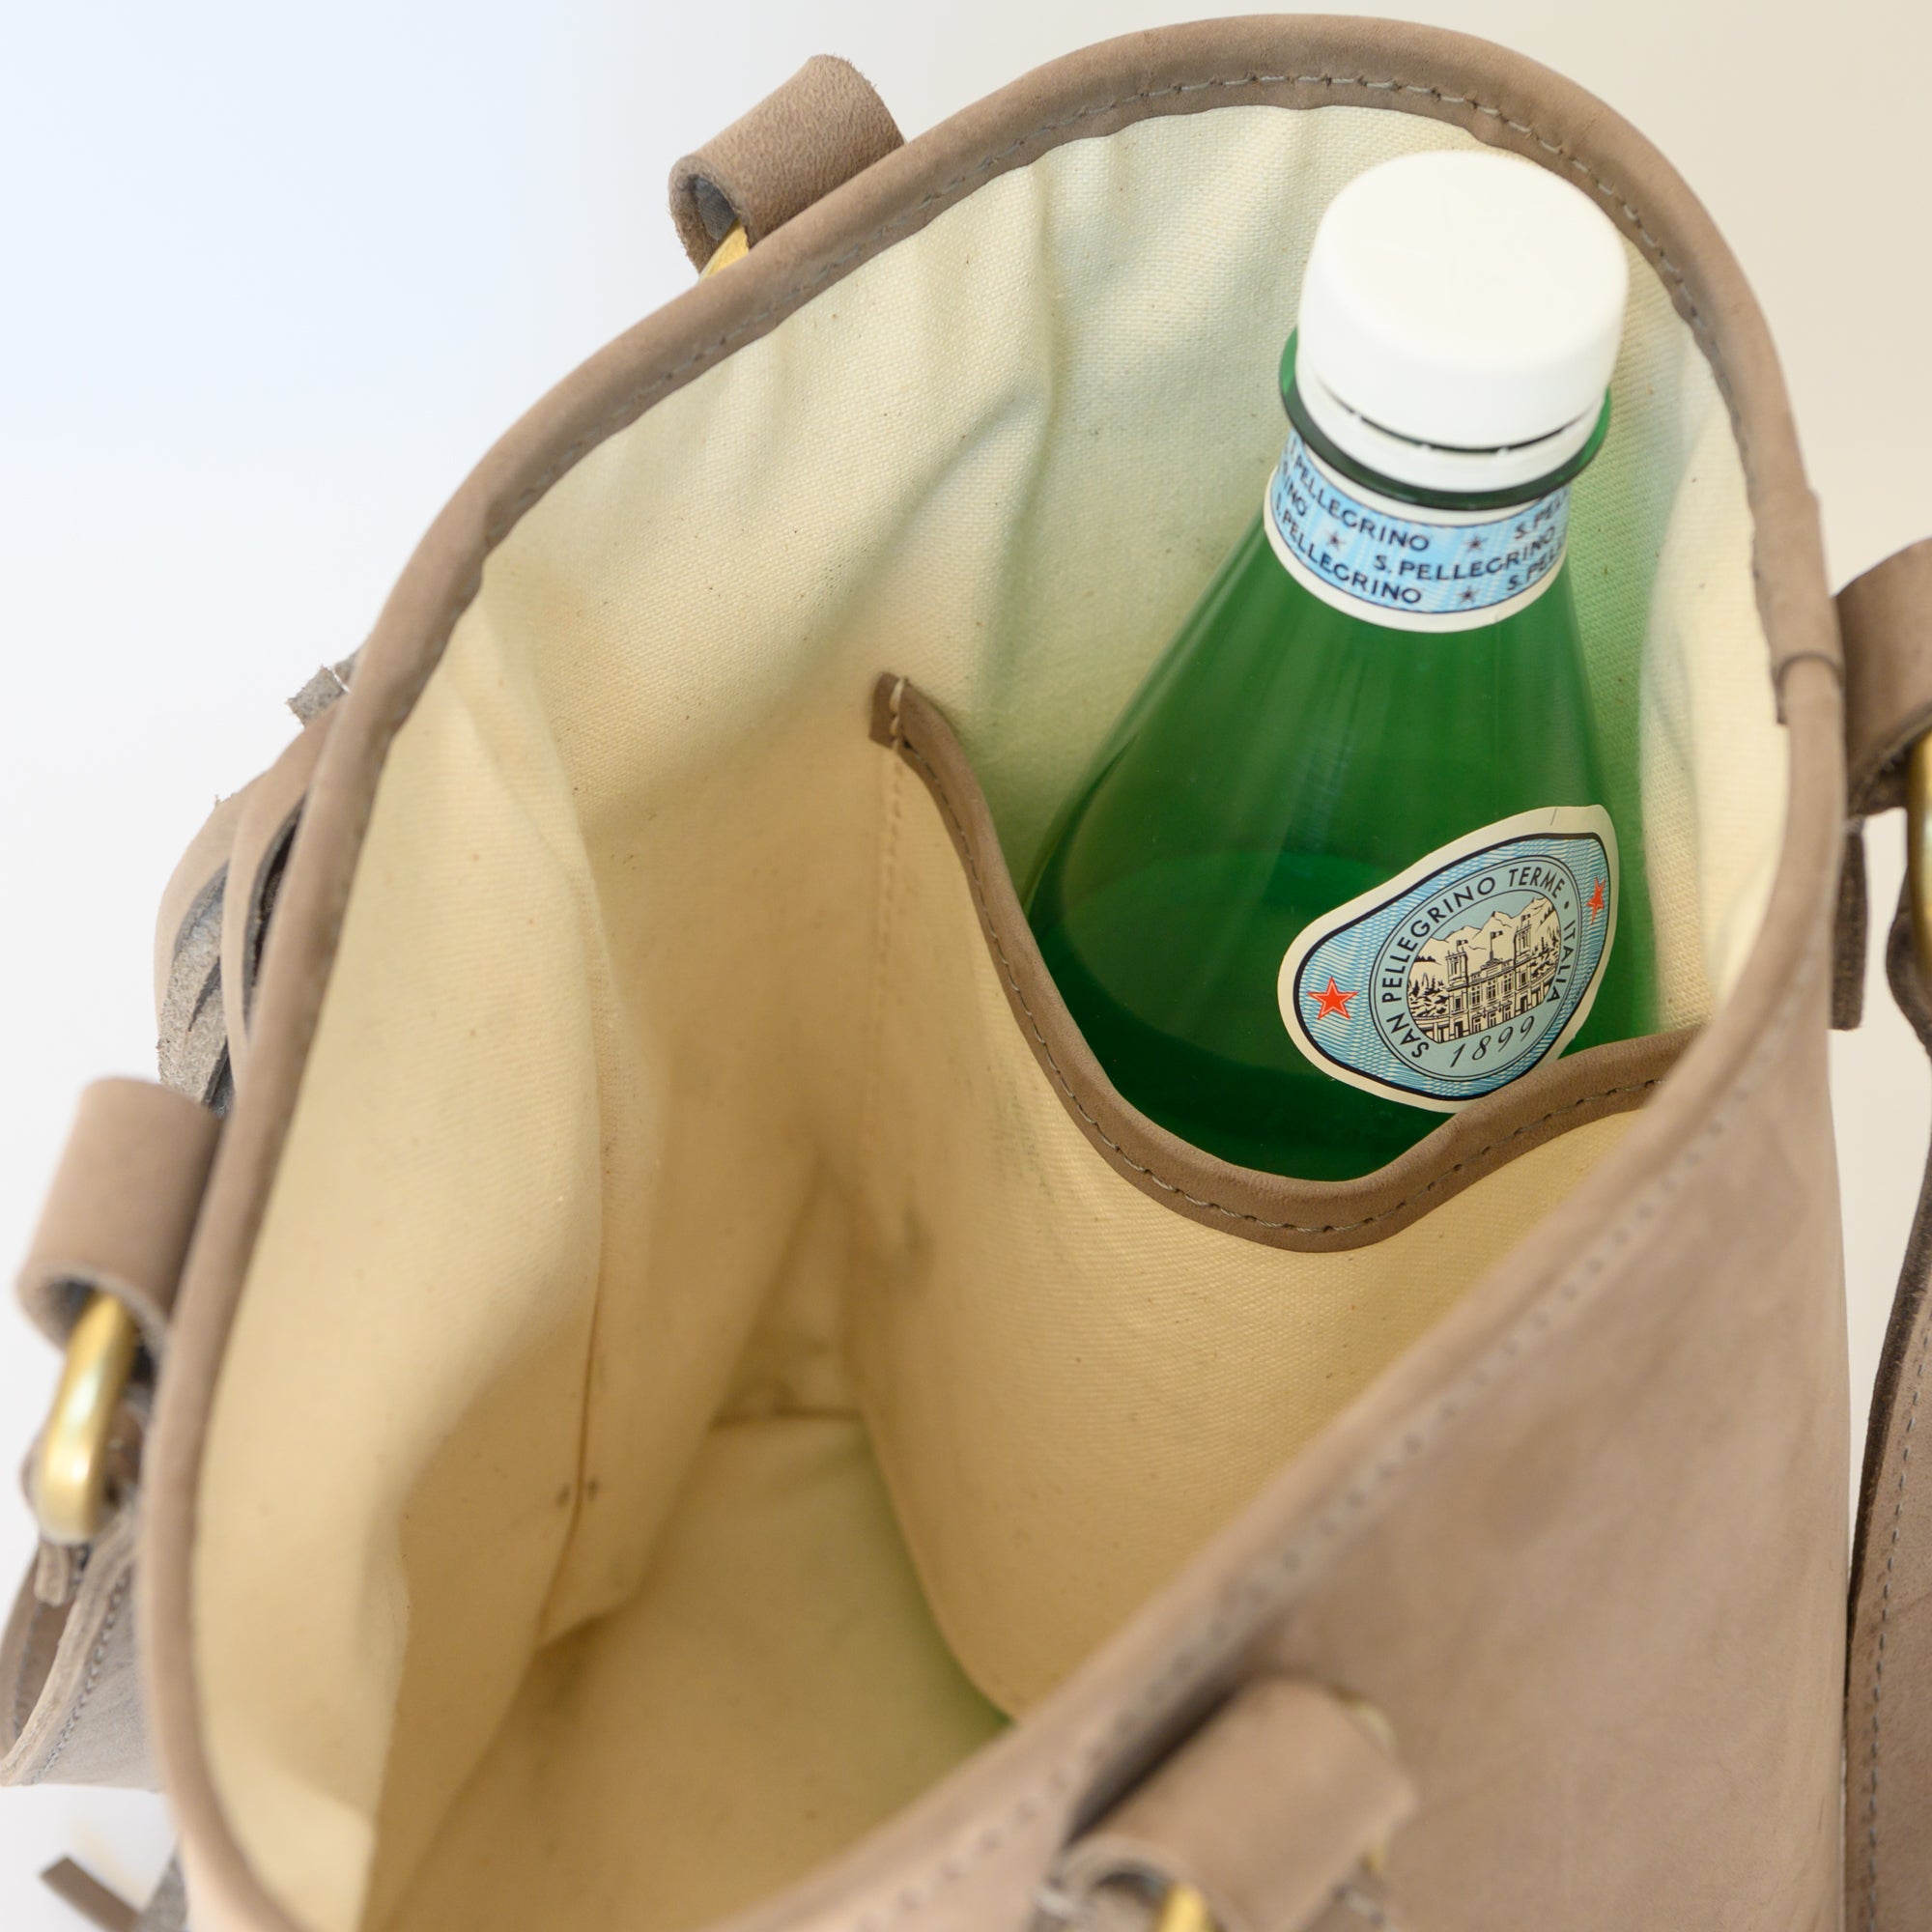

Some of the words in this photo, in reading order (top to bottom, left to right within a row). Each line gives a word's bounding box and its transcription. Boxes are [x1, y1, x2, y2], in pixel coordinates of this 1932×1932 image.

[1508, 866, 1566, 899] TERME
[1381, 875, 1496, 1004] PELLEGRINO
[1546, 919, 1577, 1004] ITALIA
[1385, 1011, 1430, 1059] SAN
[1449, 1014, 1536, 1068] 1899
